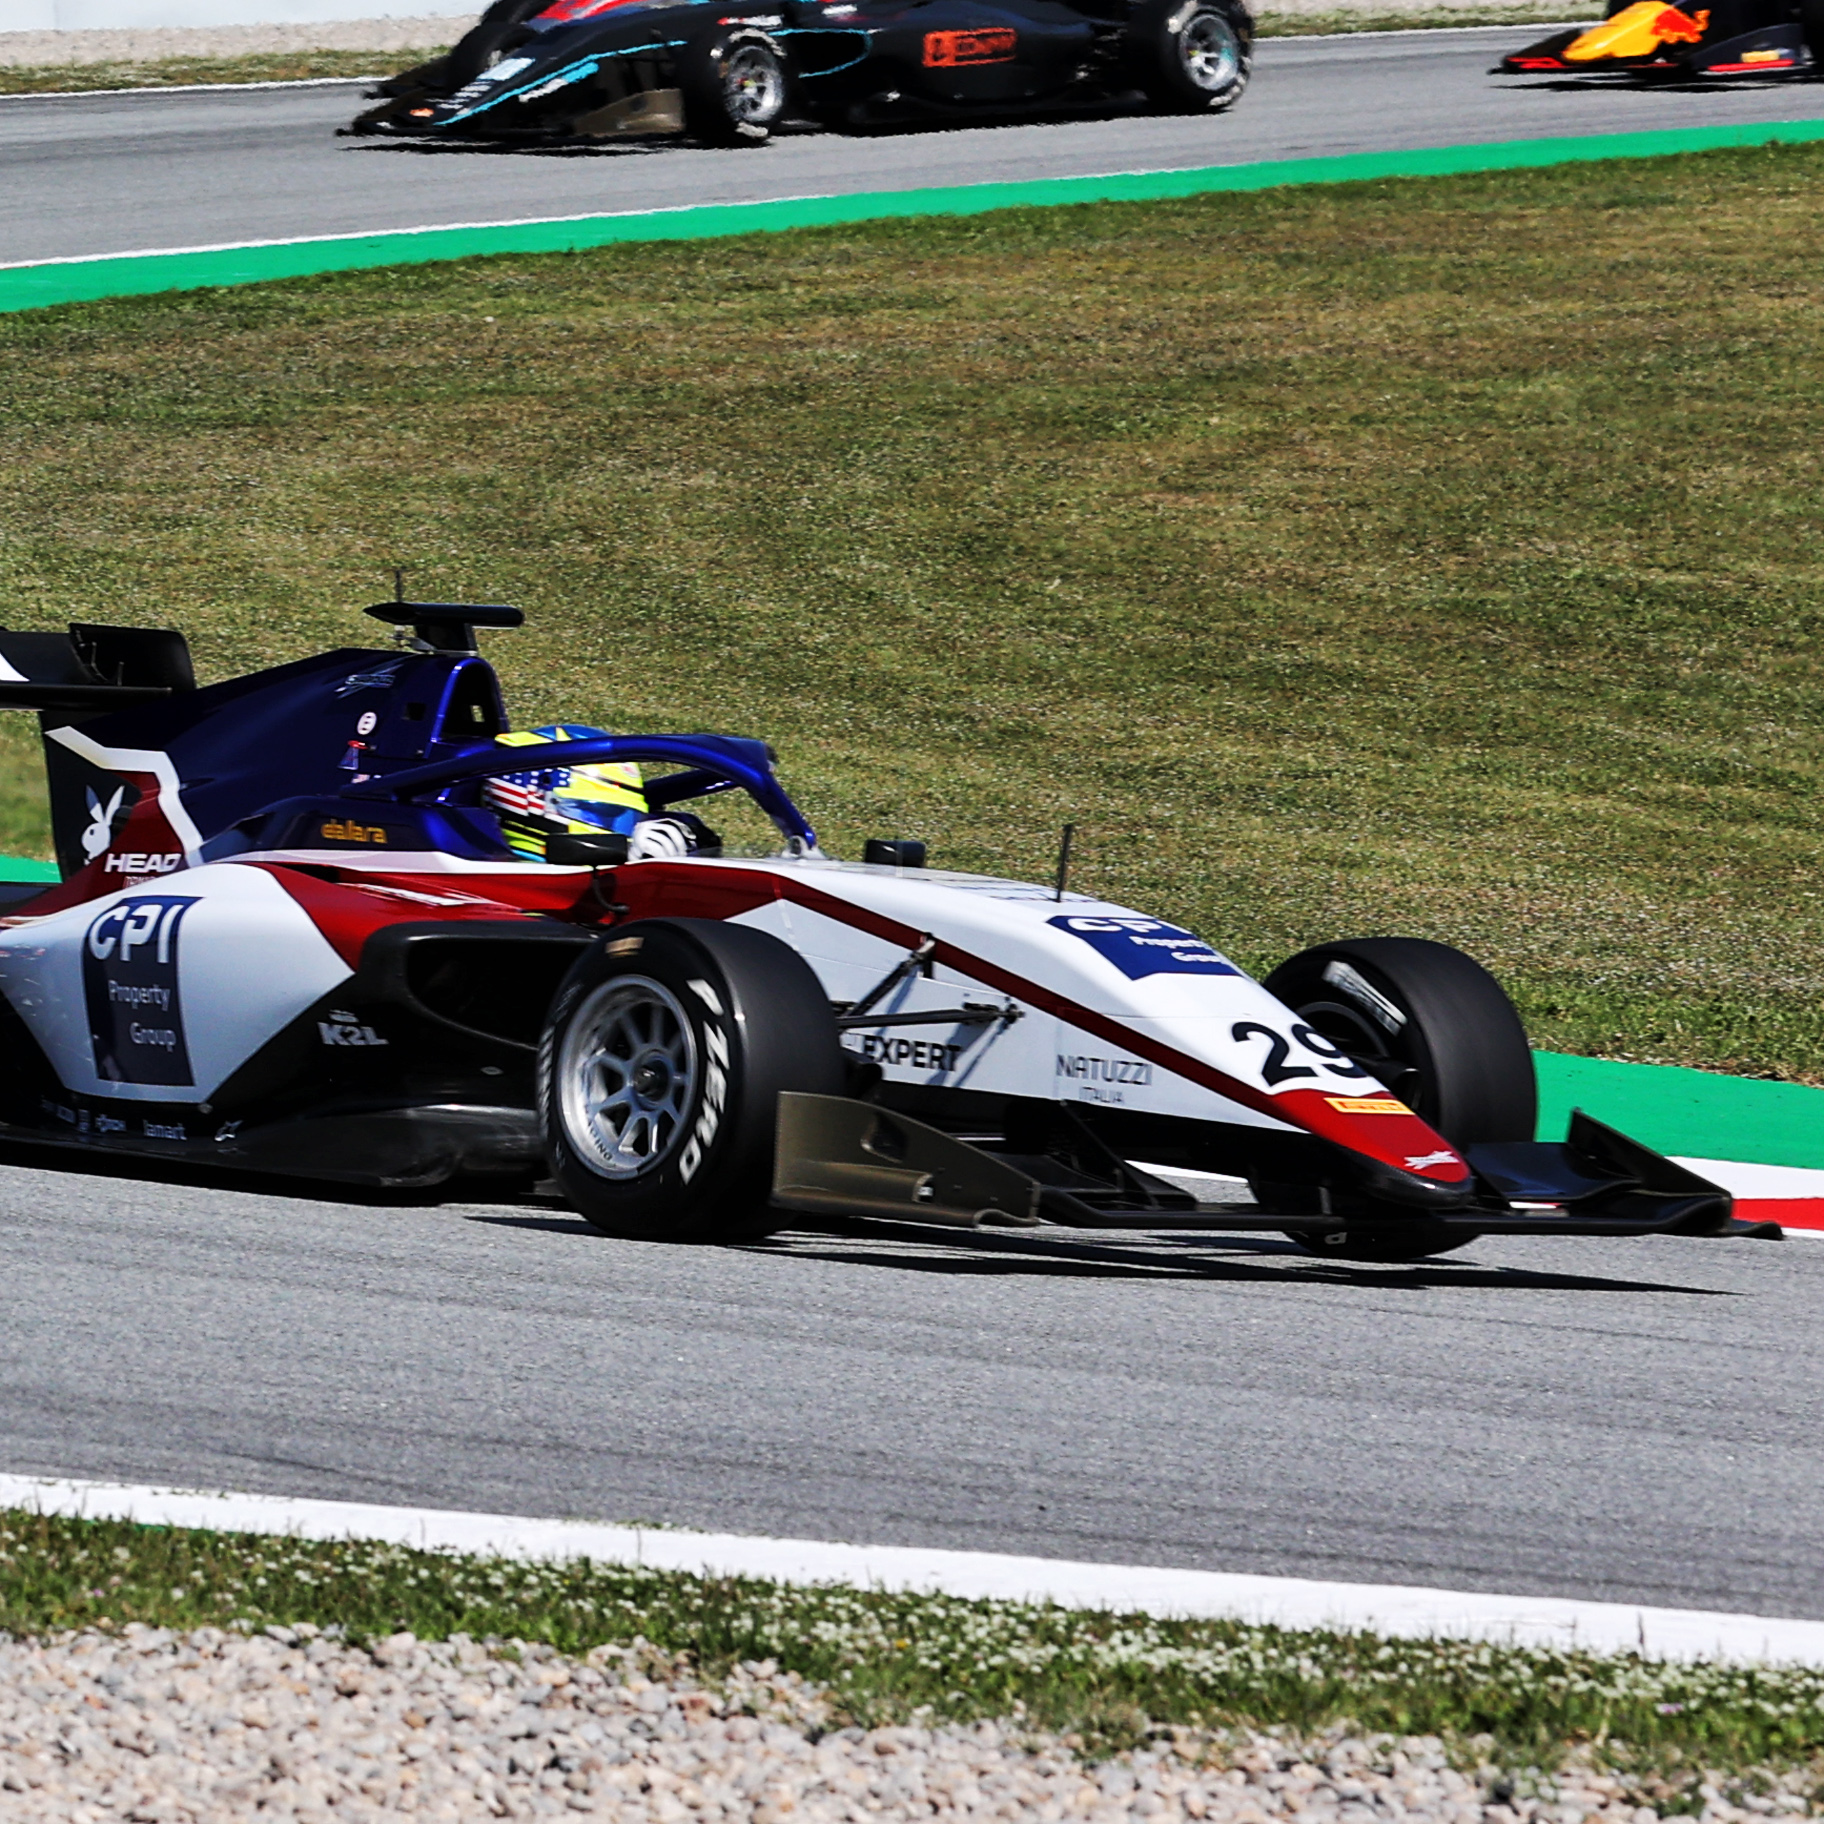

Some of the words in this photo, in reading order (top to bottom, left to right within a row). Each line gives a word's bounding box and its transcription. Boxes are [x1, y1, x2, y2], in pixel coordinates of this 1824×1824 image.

[320, 819, 388, 845] dallara
[104, 853, 182, 873] HEAD
[88, 903, 185, 964] CPI
[107, 979, 171, 1012] Property
[129, 1022, 177, 1053] Group
[863, 1034, 963, 1072] EXPERT
[1056, 1053, 1153, 1086] NATUZZI
[1231, 1021, 1370, 1088] 29
[1078, 1086, 1126, 1104] ITALIA
